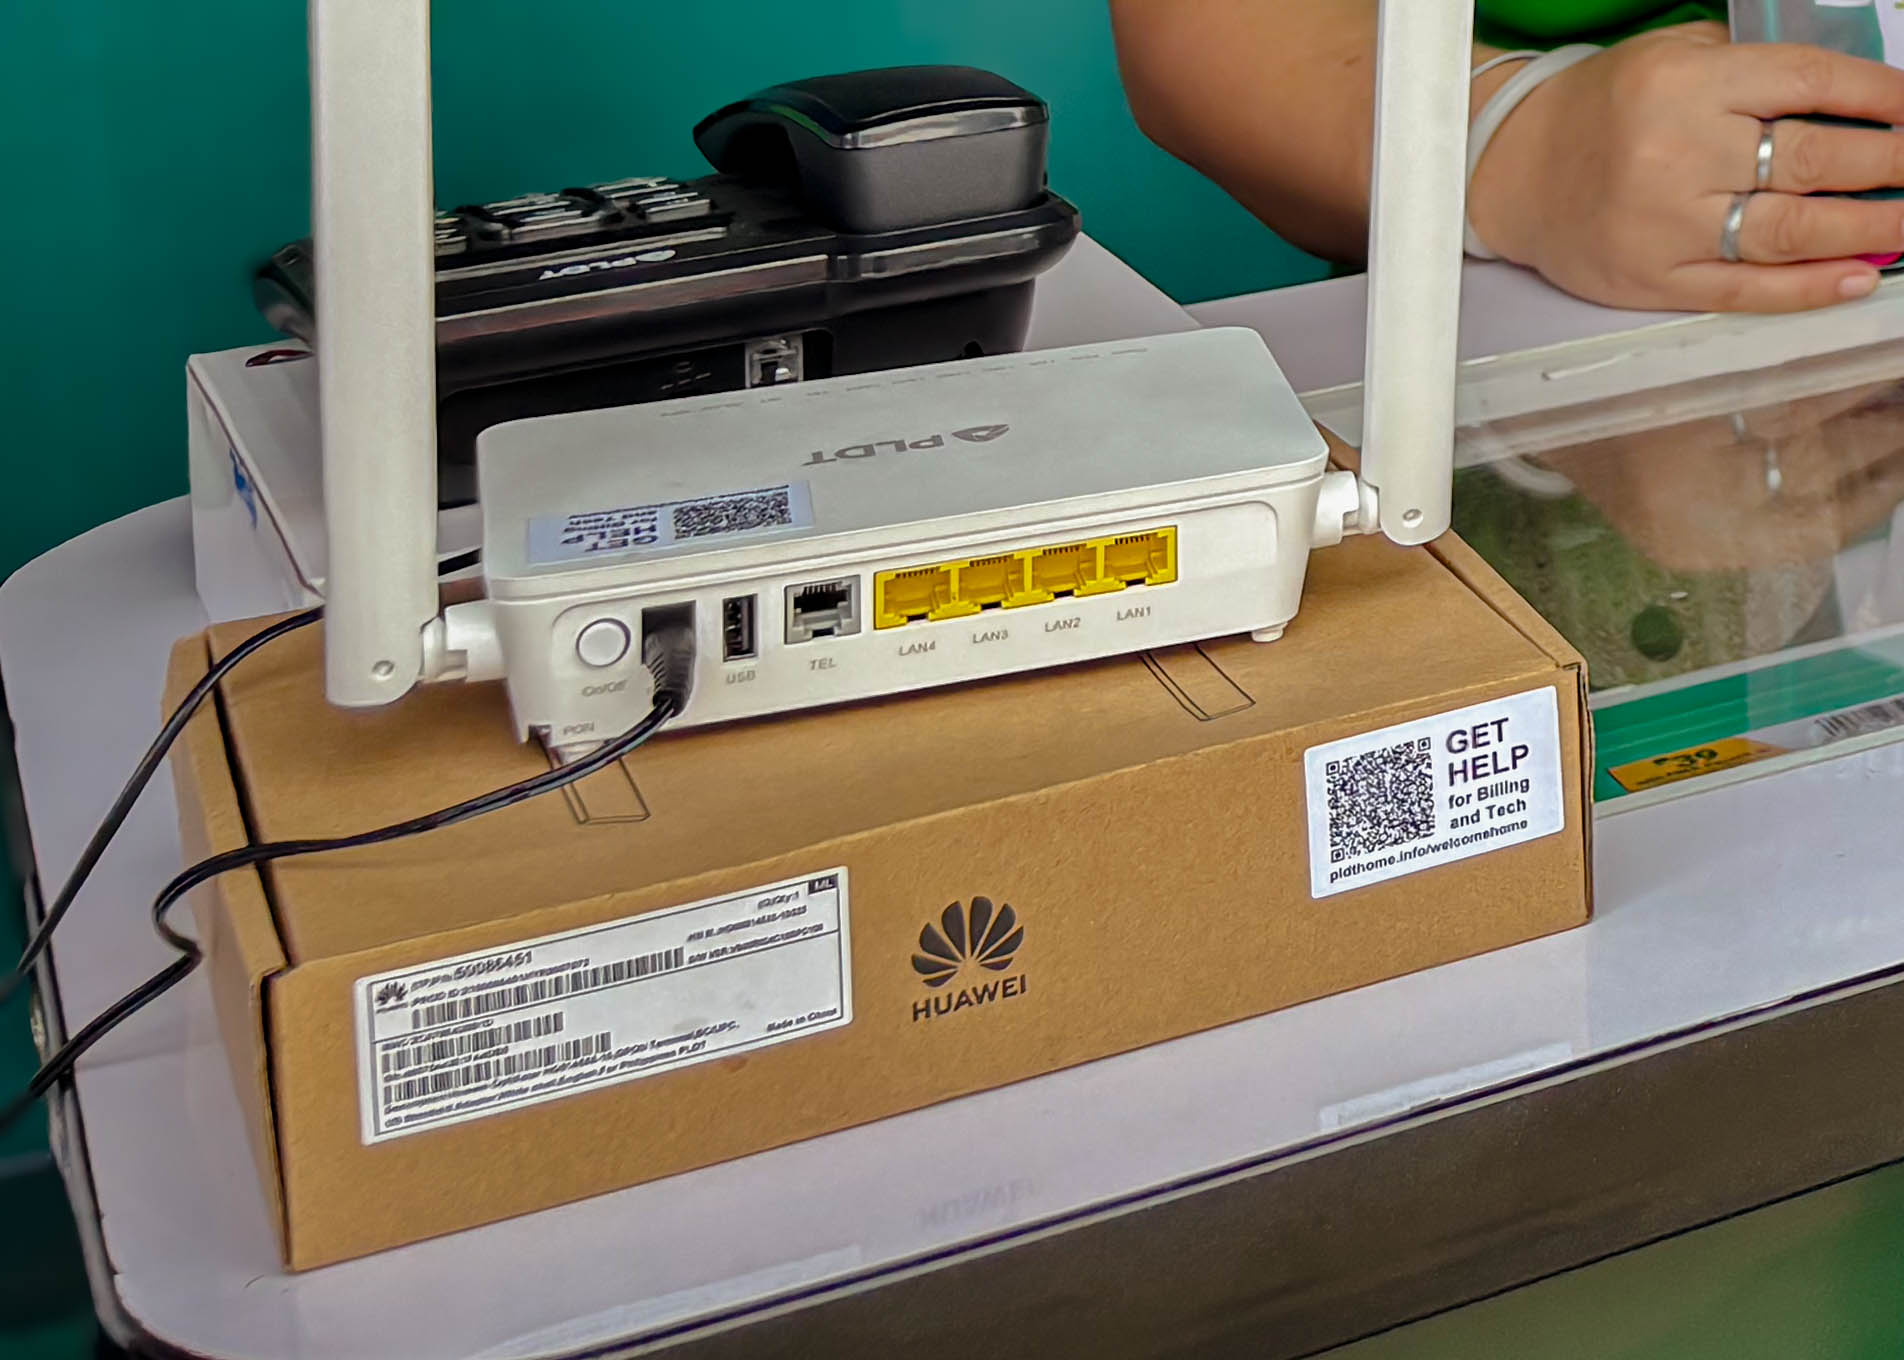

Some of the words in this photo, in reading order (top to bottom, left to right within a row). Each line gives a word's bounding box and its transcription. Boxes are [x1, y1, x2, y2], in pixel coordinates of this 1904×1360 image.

[800, 431, 946, 468] PLDT
[1044, 616, 1081, 633] LAN2
[1116, 605, 1152, 622] LAN1
[898, 640, 936, 657] LAN4
[972, 629, 1009, 645] LAN3
[725, 669, 757, 685] USB
[809, 657, 838, 671] TEL
[1445, 717, 1510, 755] GET
[1448, 744, 1530, 787] HELP
[1448, 792, 1473, 810] for
[1477, 778, 1531, 803] Billing
[1450, 809, 1481, 830] and
[1487, 798, 1527, 821] Tech
[1330, 818, 1529, 884] pldthome.info/welcomehome
[911, 973, 1028, 1023] HUAWEI
